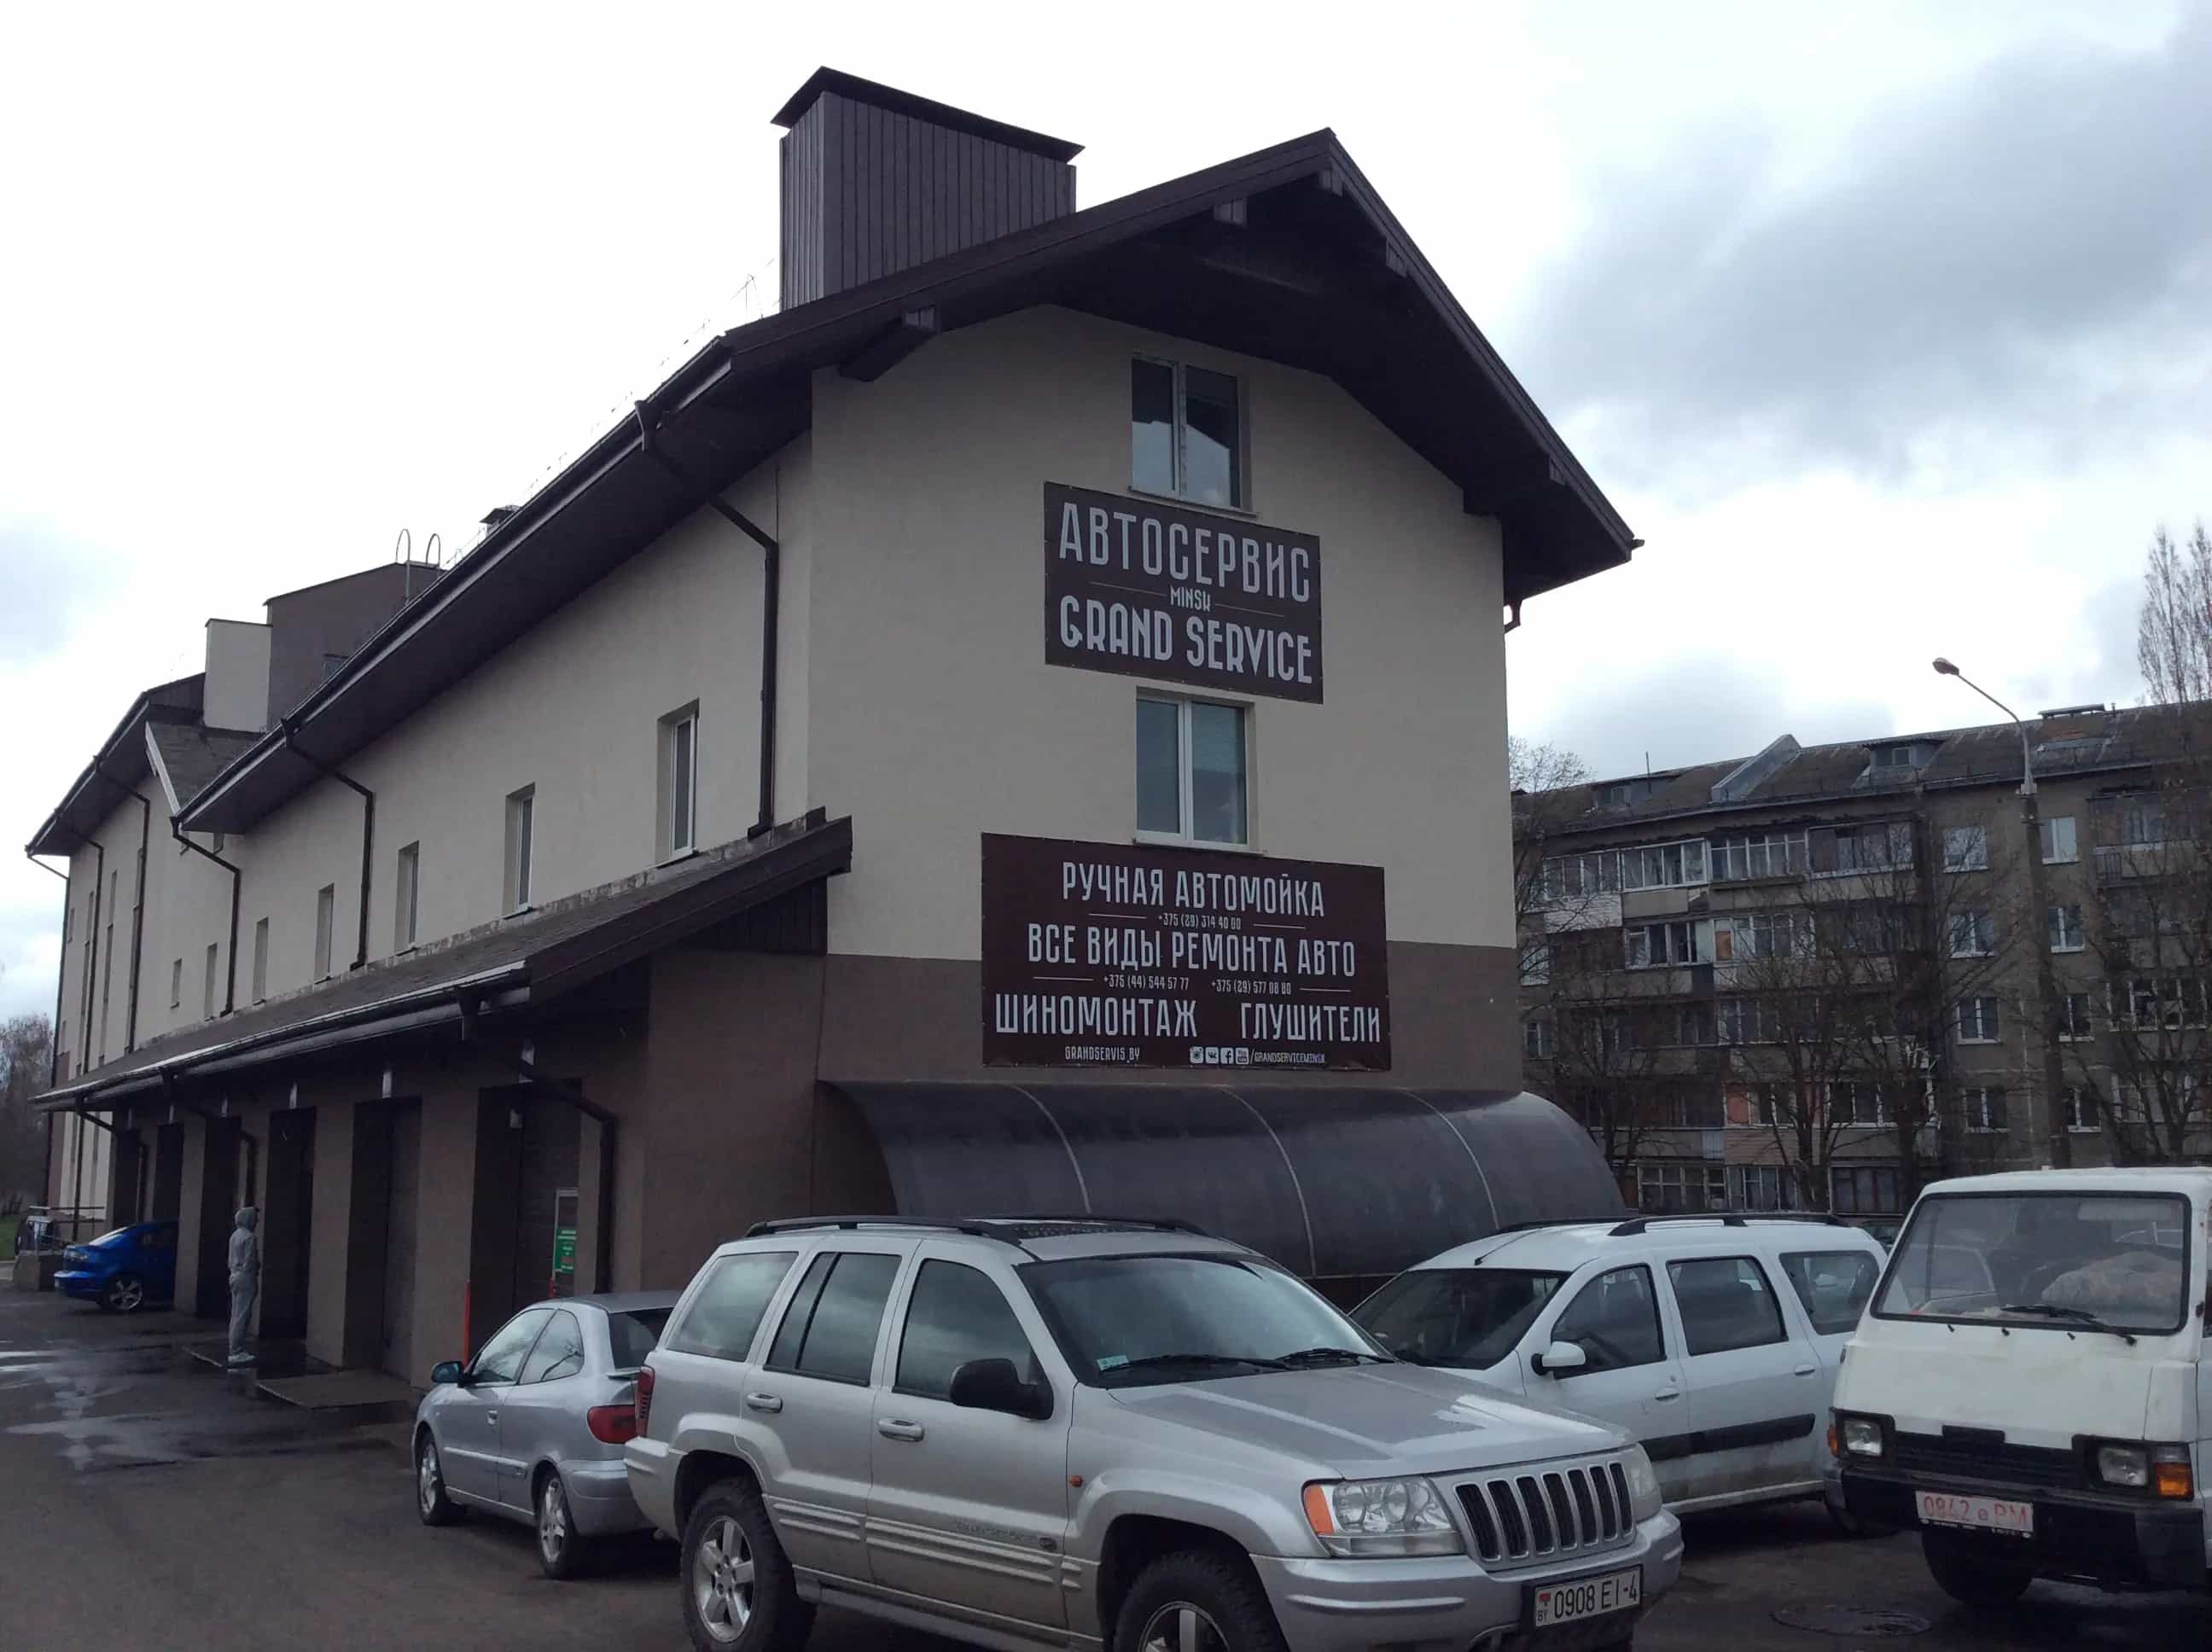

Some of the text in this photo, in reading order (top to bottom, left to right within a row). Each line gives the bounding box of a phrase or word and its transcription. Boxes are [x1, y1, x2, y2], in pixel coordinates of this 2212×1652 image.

[1059, 502, 1310, 602] АВТОСЕРВИС
[1170, 585, 1211, 612] MINSK
[1060, 596, 1313, 683] GRAND SERVICE
[1062, 862, 1324, 917] РУЧНАЯ АВТОМОЙКА
[1158, 913, 1179, 927] +375
[1181, 914, 1199, 928] (29)
[1219, 916, 1229, 929] 40
[1027, 922, 1355, 977] ВСЕ ВИДЫ РЕМОНТА АВТО
[1103, 974, 1189, 990] +375 (44) 544 57 77
[1212, 979, 1231, 992] +375
[1233, 980, 1251, 994] (29)
[1253, 980, 1266, 994] 577
[996, 992, 1197, 1038] ШИНОМОНТАЖ
[1241, 1003, 1381, 1043] ГЛУШИТЕЛИ
[1538, 1609, 1548, 1621] BY
[1554, 1585, 1596, 1618] 0908
